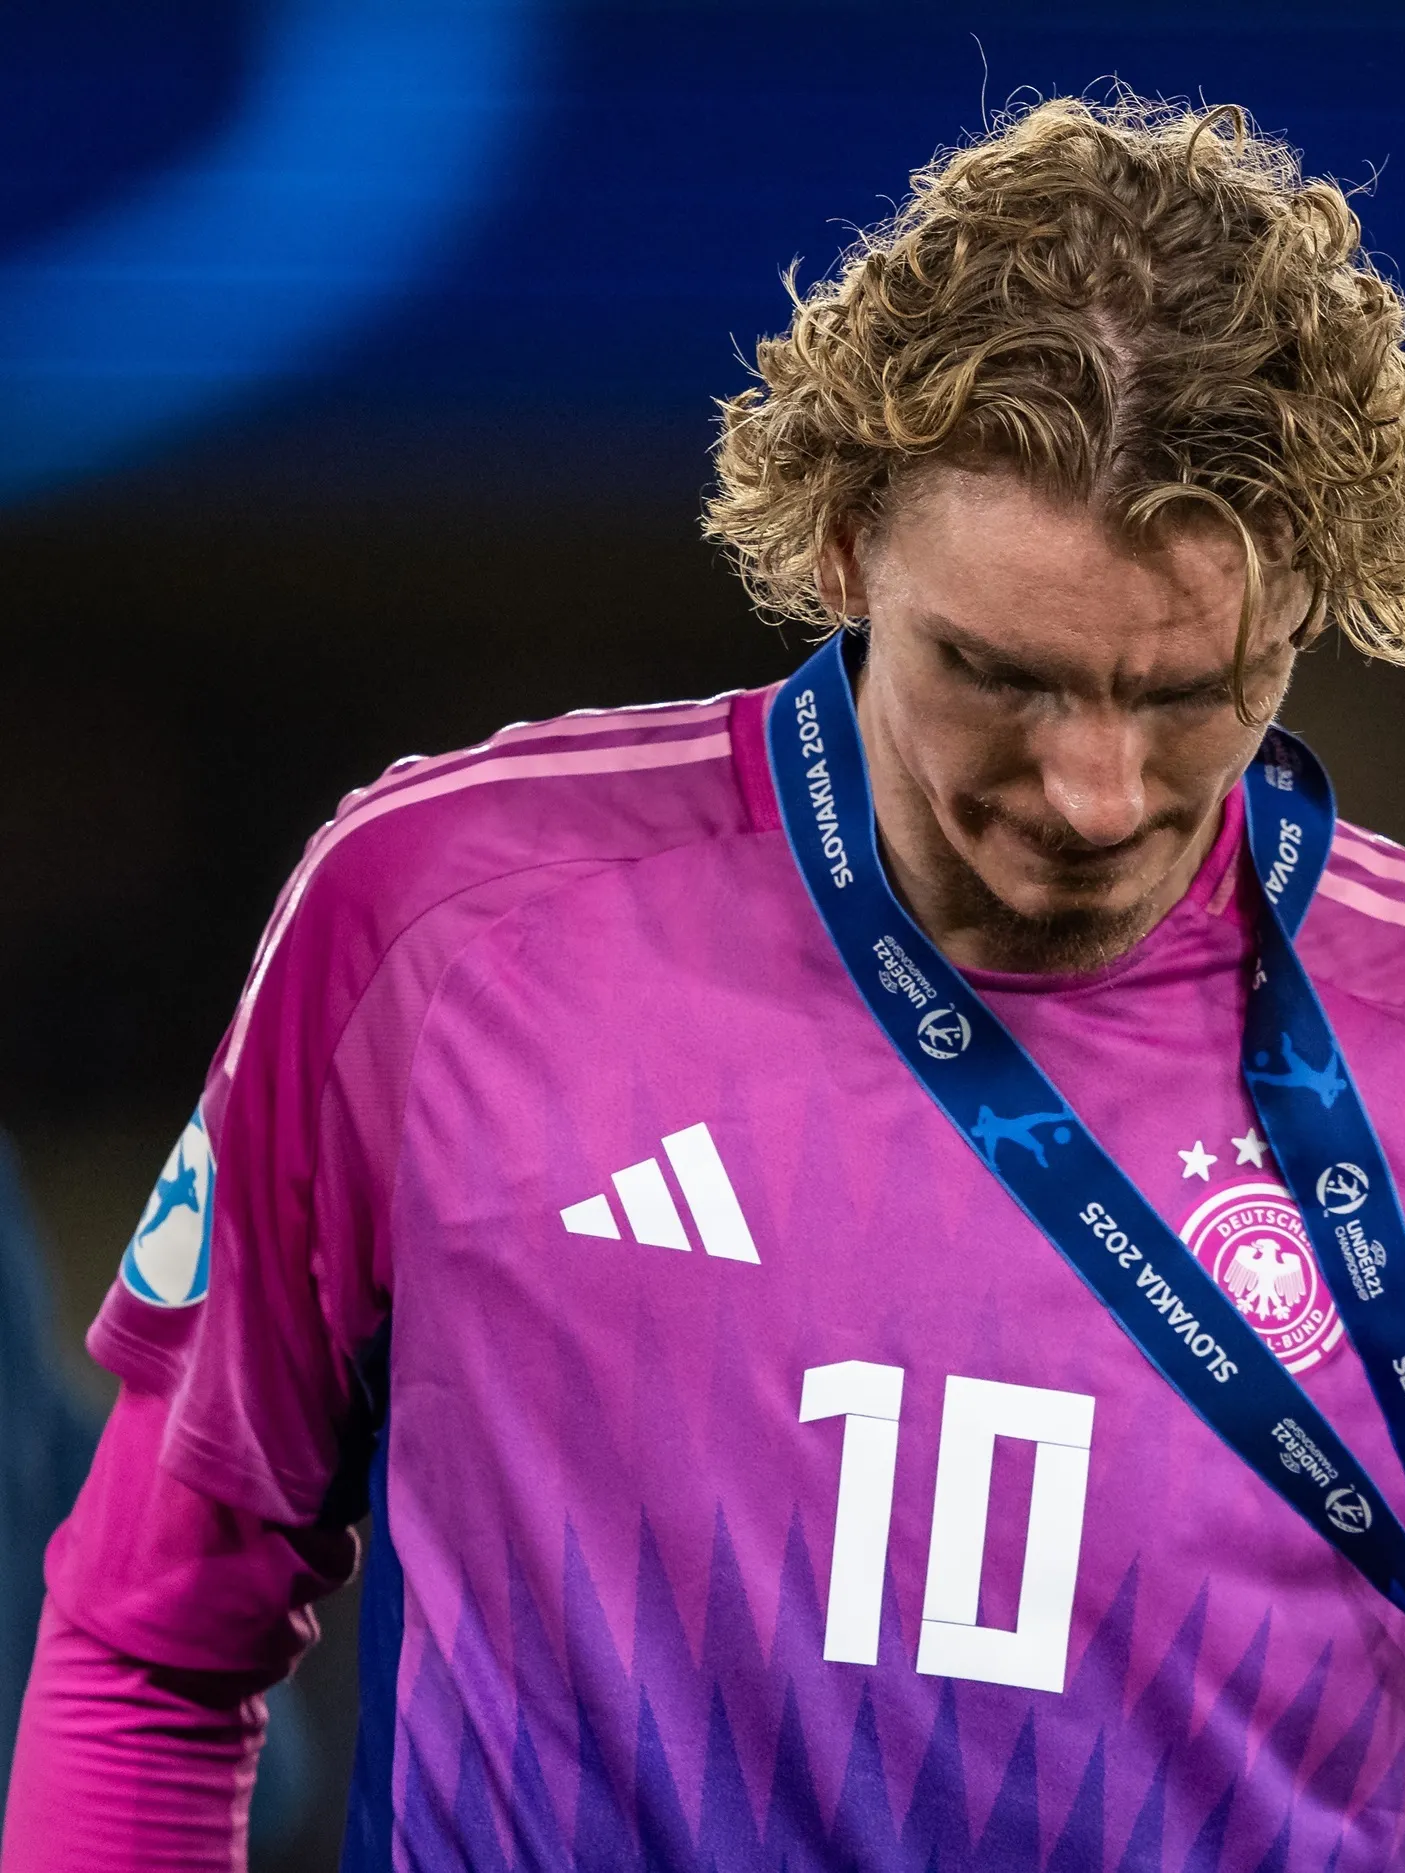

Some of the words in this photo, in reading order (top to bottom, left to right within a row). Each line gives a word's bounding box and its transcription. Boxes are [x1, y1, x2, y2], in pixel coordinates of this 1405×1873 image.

[795, 689, 824, 758] 2025
[806, 759, 854, 889] SLOVAKIA
[872, 938, 928, 1009] UNDER21
[1079, 1202, 1143, 1269] 2025
[1346, 1219, 1385, 1299] UNDER21
[1136, 1262, 1239, 1383] SLOVAKIA
[1271, 1422, 1330, 1487] UNDER21
[799, 1360, 1096, 1693] 10
